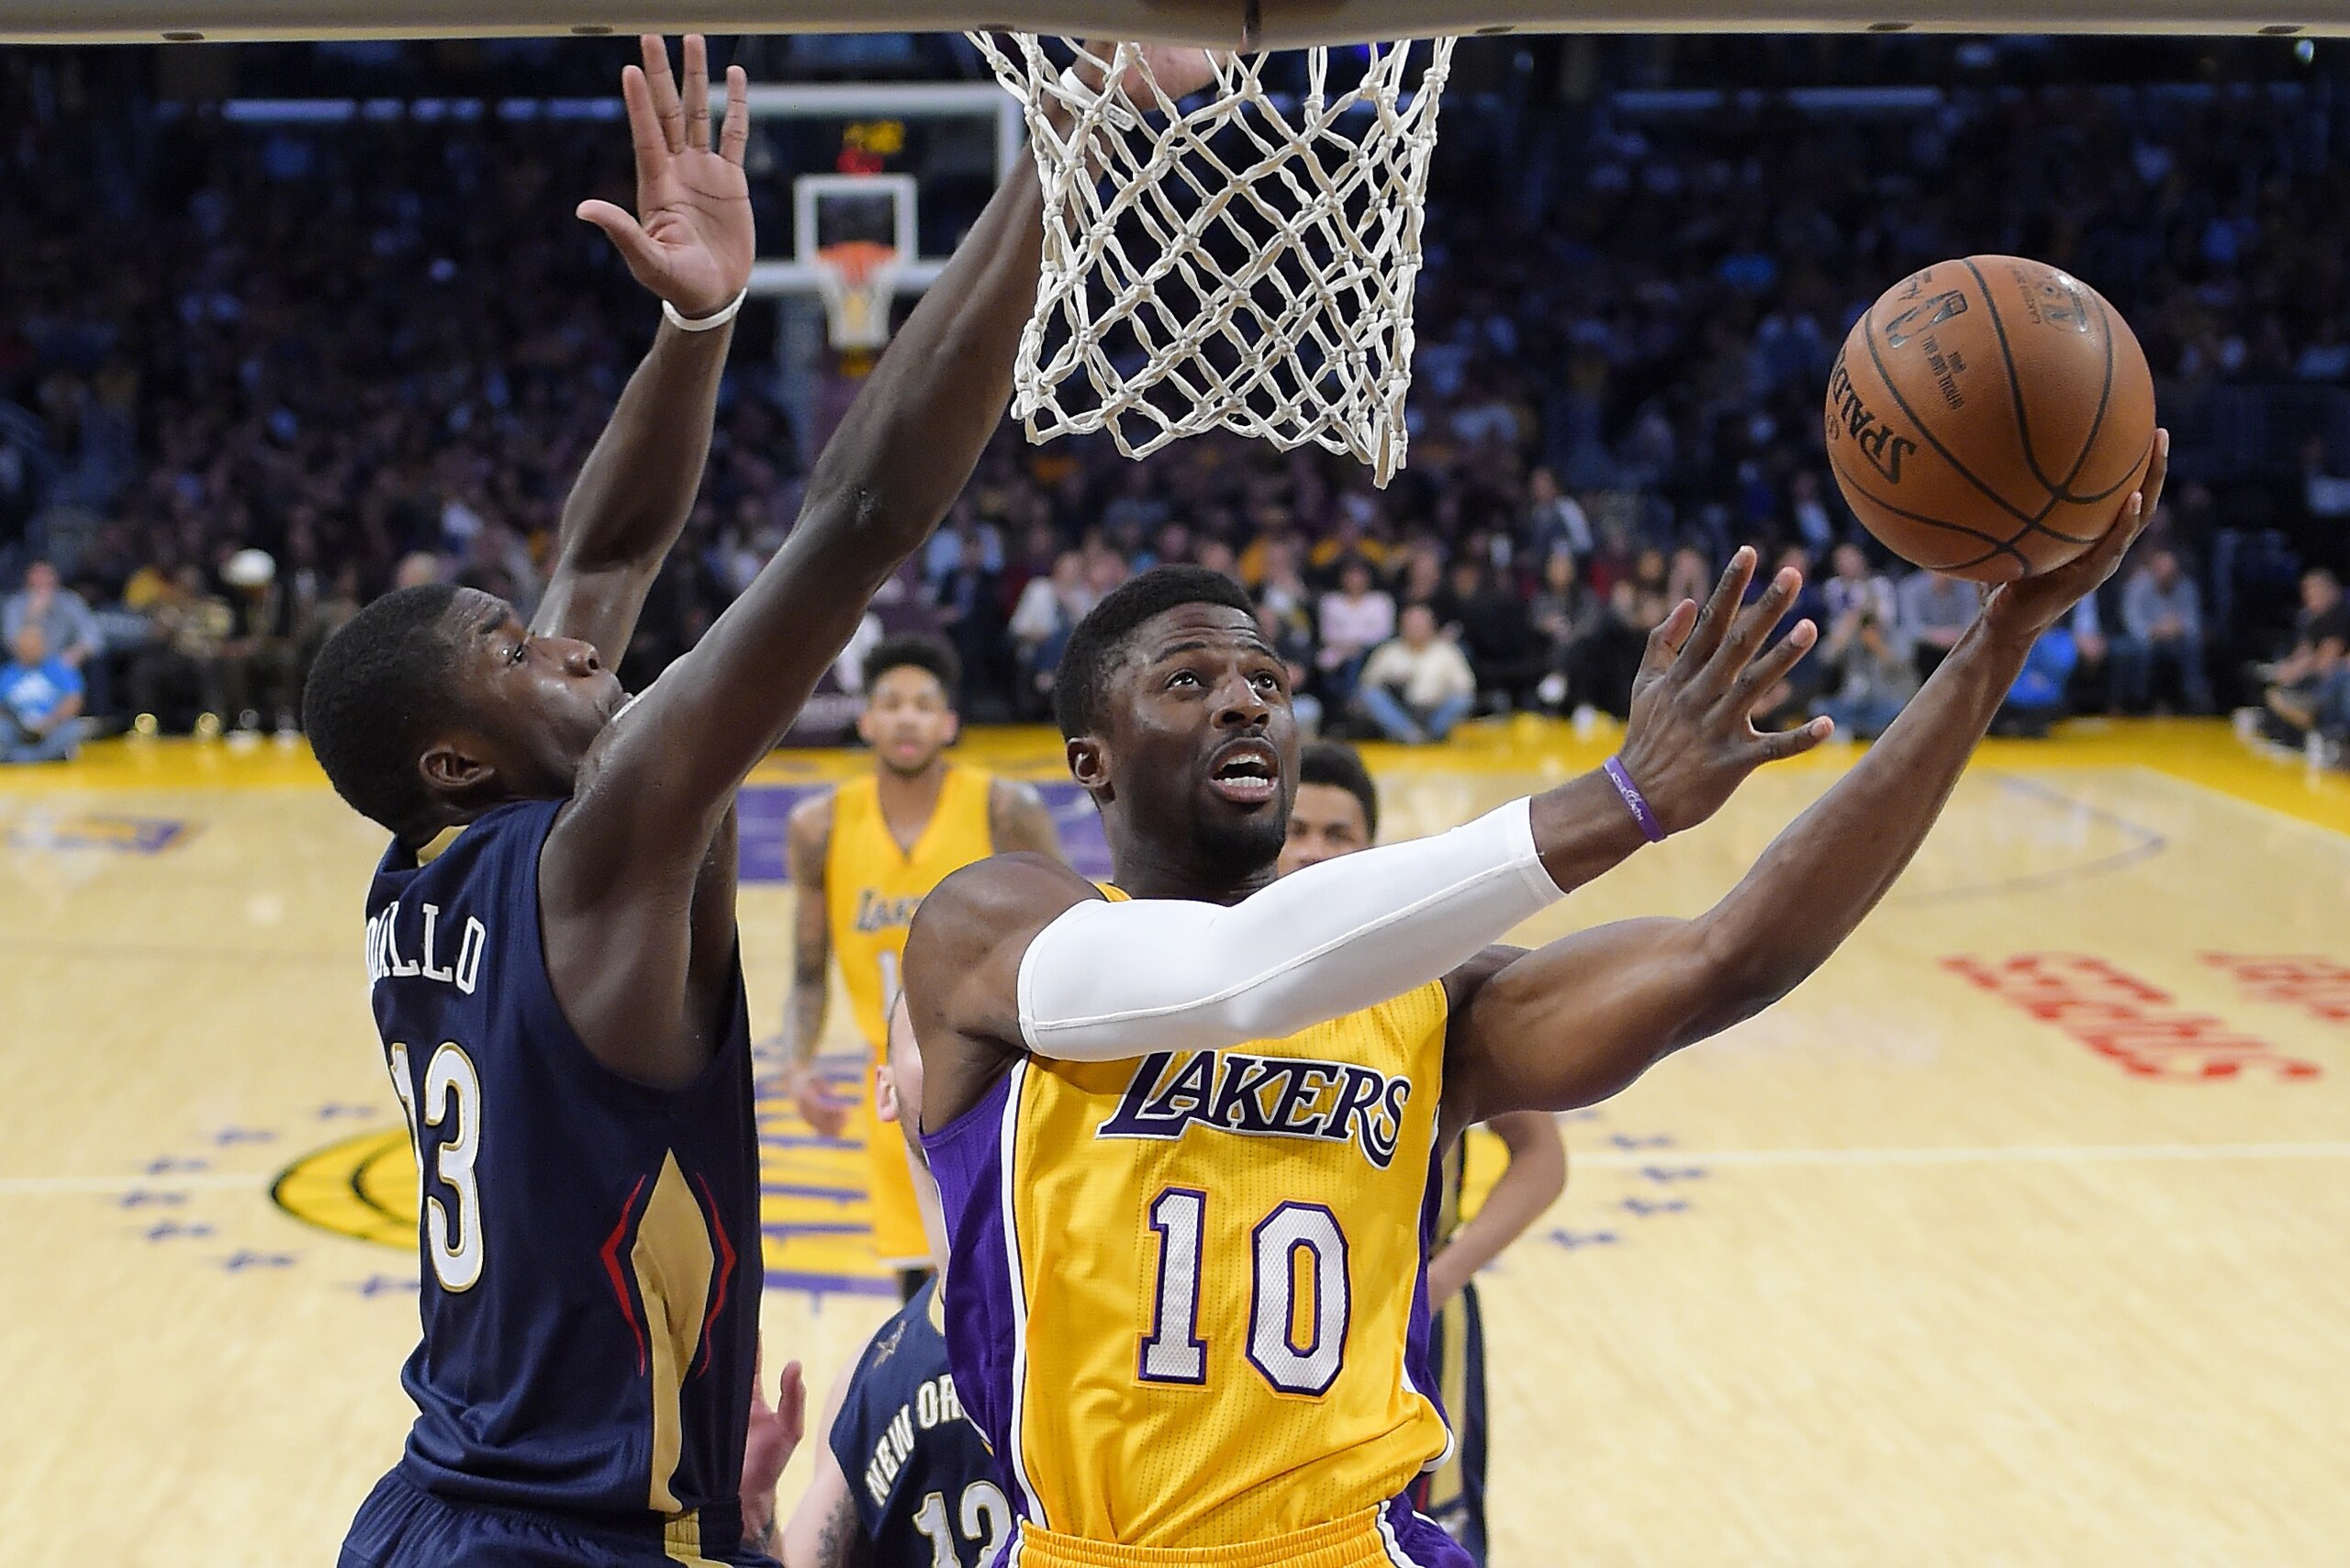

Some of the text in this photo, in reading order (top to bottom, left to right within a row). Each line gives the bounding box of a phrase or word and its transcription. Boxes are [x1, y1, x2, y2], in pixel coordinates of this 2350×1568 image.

[1832, 347, 1917, 485] SPALD
[1094, 1049, 1412, 1171] LAKERS
[1135, 1184, 1352, 1401] 10
[864, 1404, 915, 1507] NEW
[912, 1480, 1013, 1568] 12
